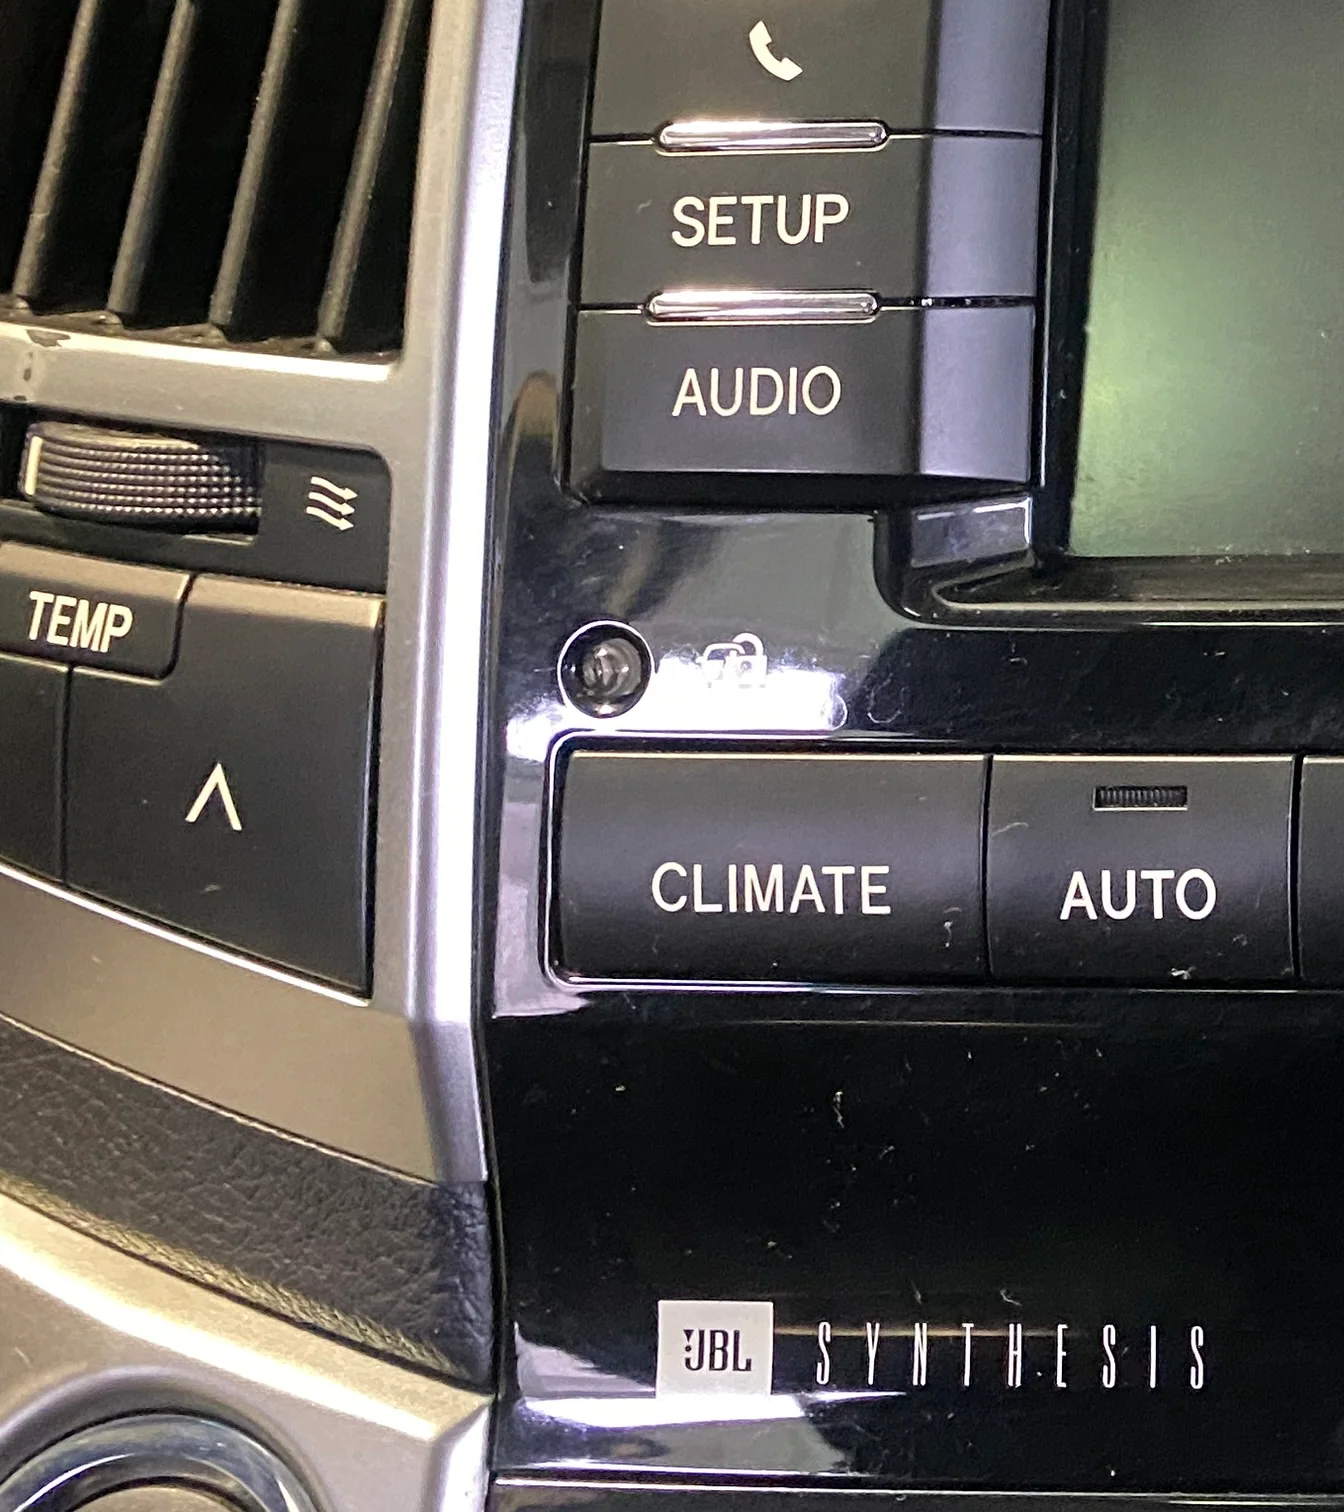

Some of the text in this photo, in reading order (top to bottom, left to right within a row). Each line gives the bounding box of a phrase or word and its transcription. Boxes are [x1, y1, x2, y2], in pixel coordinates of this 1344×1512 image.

[670, 193, 850, 248] SETUP
[671, 365, 843, 418] AUDIO
[28, 590, 133, 653] TEMP
[651, 862, 891, 915] CLIMATE
[1060, 869, 1217, 920] AUTO
[683, 1321, 1206, 1390] JBL SYNTHESIS
